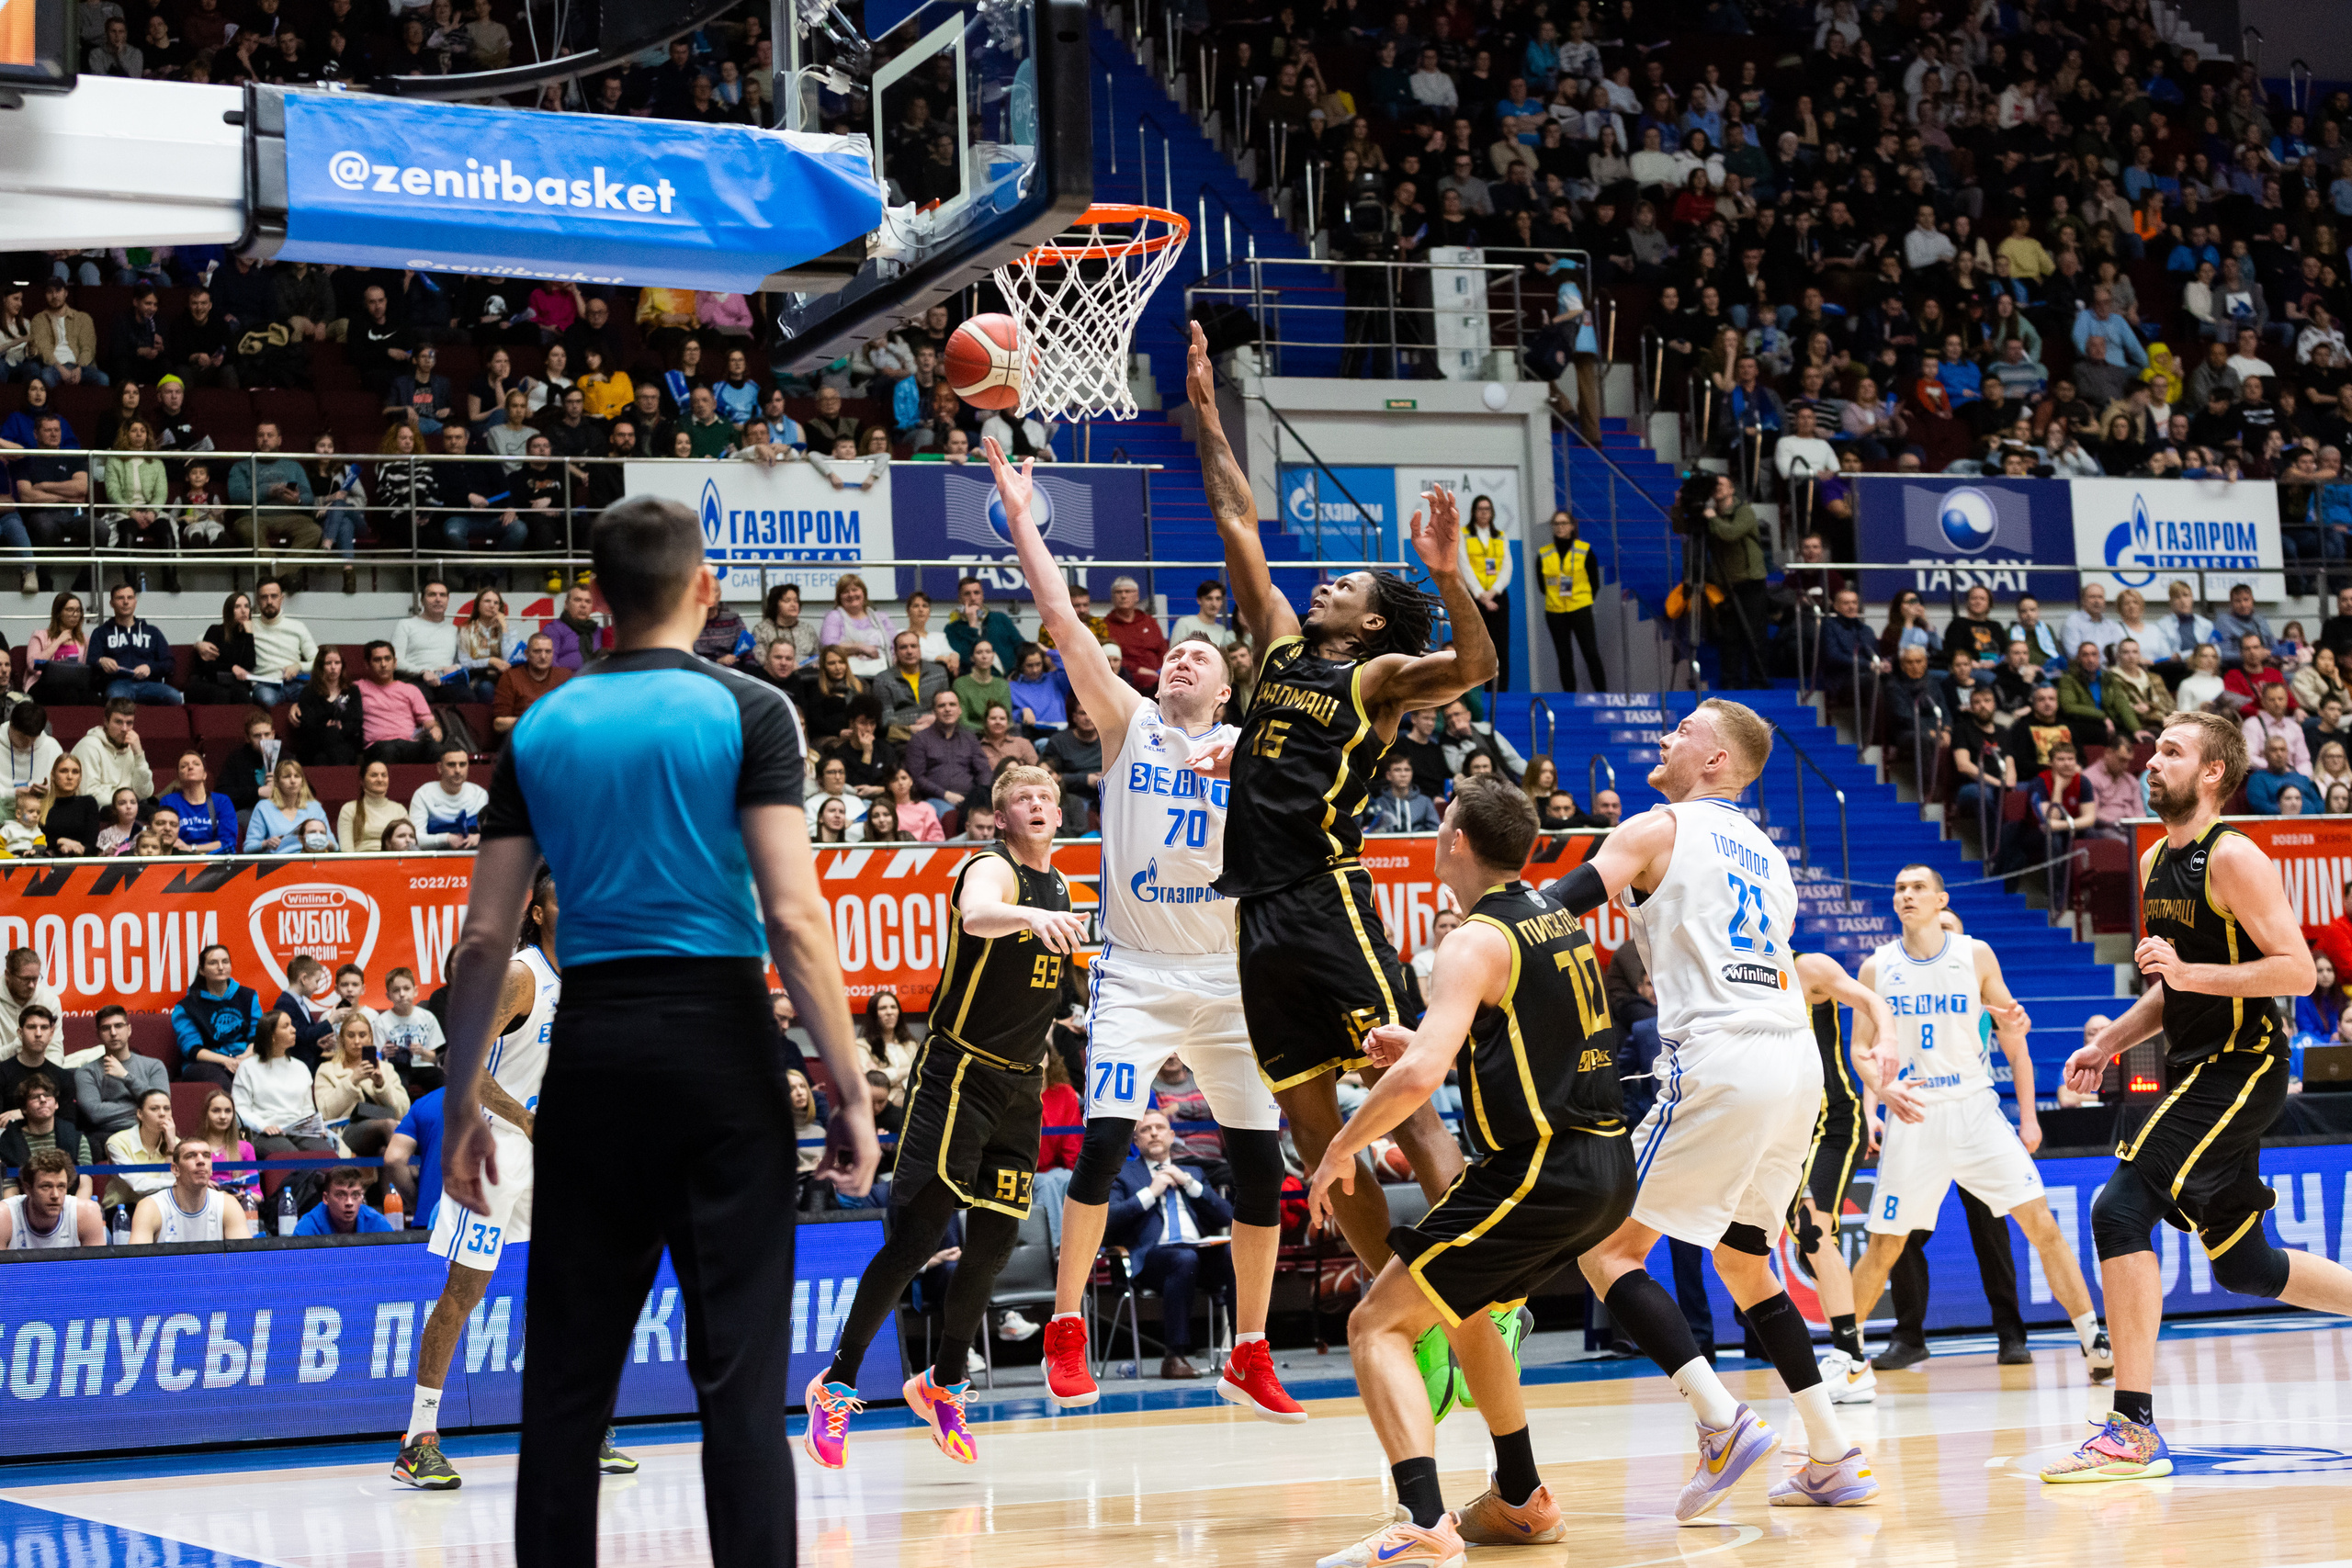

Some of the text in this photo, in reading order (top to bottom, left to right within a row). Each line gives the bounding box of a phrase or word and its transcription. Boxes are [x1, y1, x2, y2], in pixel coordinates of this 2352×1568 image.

[328, 151, 676, 213] @zenitbasket
[729, 510, 861, 545] ГАЗПРОМ
[2155, 522, 2257, 551] ГАЗПРОМ
[948, 555, 1095, 590] TASY
[1908, 558, 2032, 592] TASSAY
[1623, 710, 1663, 724] TASSA
[1144, 744, 1167, 753] KELME
[1252, 718, 1293, 759] 15
[1164, 807, 1209, 849] 70
[1710, 831, 1770, 880] ТОРОПОВ
[288, 894, 328, 904] Winline
[410, 876, 469, 889] 2022/23
[2272, 854, 2352, 928] WIN
[278, 909, 351, 944] КУБОК
[1728, 873, 1778, 956] 21
[1030, 954, 1062, 989] 93
[1727, 965, 1777, 985] Winline
[899, 984, 935, 995] СЕЗО
[1553, 942, 1612, 1041] 10
[1921, 1023, 1934, 1050] 8
[1093, 1062, 1136, 1102] 70
[995, 1168, 1033, 1203] 93
[1883, 1195, 1899, 1221] 8
[467, 1223, 502, 1257] 33
[0, 1308, 273, 1400] ОНУСЫ
